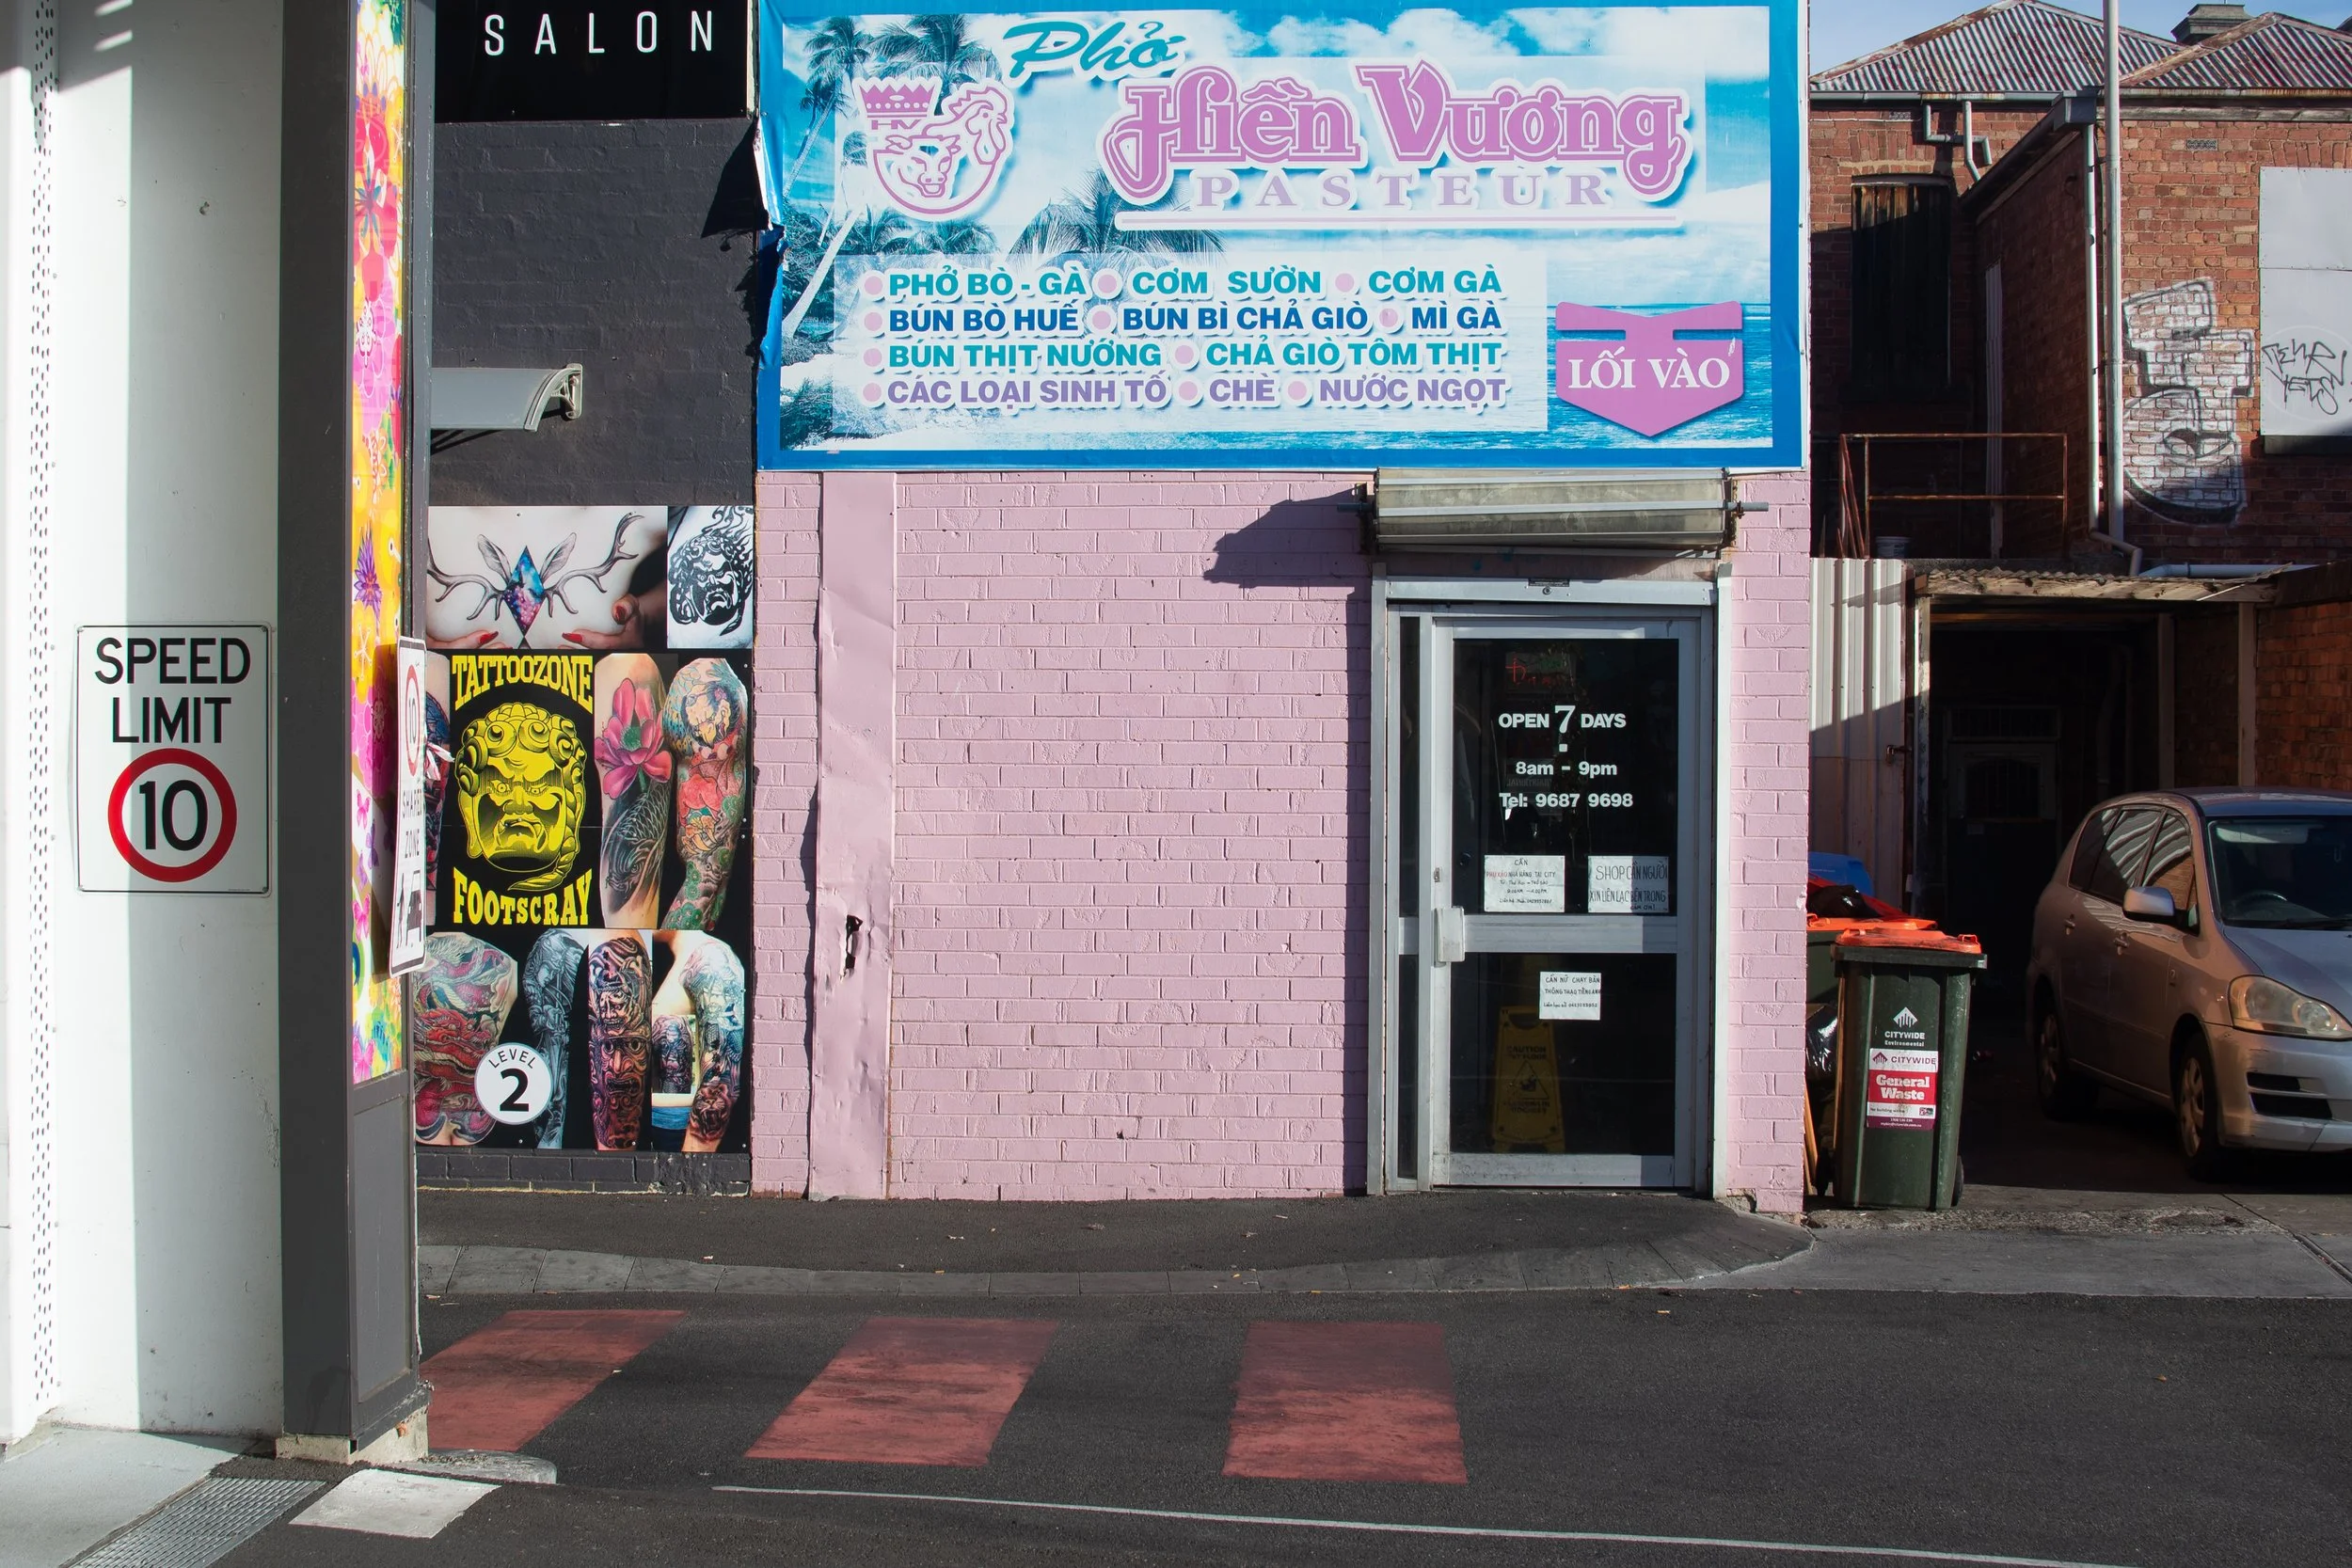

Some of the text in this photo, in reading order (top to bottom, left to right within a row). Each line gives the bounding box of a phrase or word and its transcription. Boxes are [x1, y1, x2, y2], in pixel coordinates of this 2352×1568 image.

[485, 10, 712, 56] SALON
[1003, 21, 1186, 78] Phở
[871, 119, 921, 130] HV
[1104, 59, 1688, 198] Hiền Vương
[1197, 174, 1605, 207] PASTEUR
[889, 264, 959, 296] PHỞ
[967, 267, 1013, 296] BÒ
[1039, 265, 1086, 296] GÀ
[1133, 266, 1208, 294] CƠM
[1228, 264, 1322, 294] SƯỜN
[1369, 266, 1444, 293] CƠM
[1454, 264, 1502, 293] GÀ
[889, 298, 1502, 332] BÚN BÒ HUẾ BÚN BÌ CHẢ GIÒ MÌ GÀ
[889, 334, 1502, 373] BÚN THỊT NƯỚNG CHẢ GIÒ TÔM THỊT
[1568, 346, 1730, 388] LỐI VÀO
[887, 371, 1505, 409] CÁC LOẠI SINH TỐ CHÈ NƯỚC NGỌT
[94, 637, 251, 685] SPEED
[452, 655, 593, 714] TATTOOZONE
[112, 697, 232, 744] LIMIT
[408, 698, 417, 745] 10
[1498, 705, 1627, 734] OPEN 7 DAYS
[1516, 761, 1554, 776] 8am
[1579, 761, 1618, 779] 9pm
[139, 779, 209, 851] 10
[1499, 793, 1633, 808] Tel: 9687 9698
[405, 829, 420, 858] ZONE
[1596, 865, 1625, 880] SHOP
[453, 866, 593, 926] FOOTSCRAY
[1884, 1031, 1926, 1039] CITYWIDE
[488, 1048, 536, 1069] LEVEL
[1891, 1056, 1936, 1065] CITYWIDE
[500, 1068, 529, 1112] 2
[1876, 1074, 1931, 1088] General
[1881, 1086, 1925, 1101] Waste
